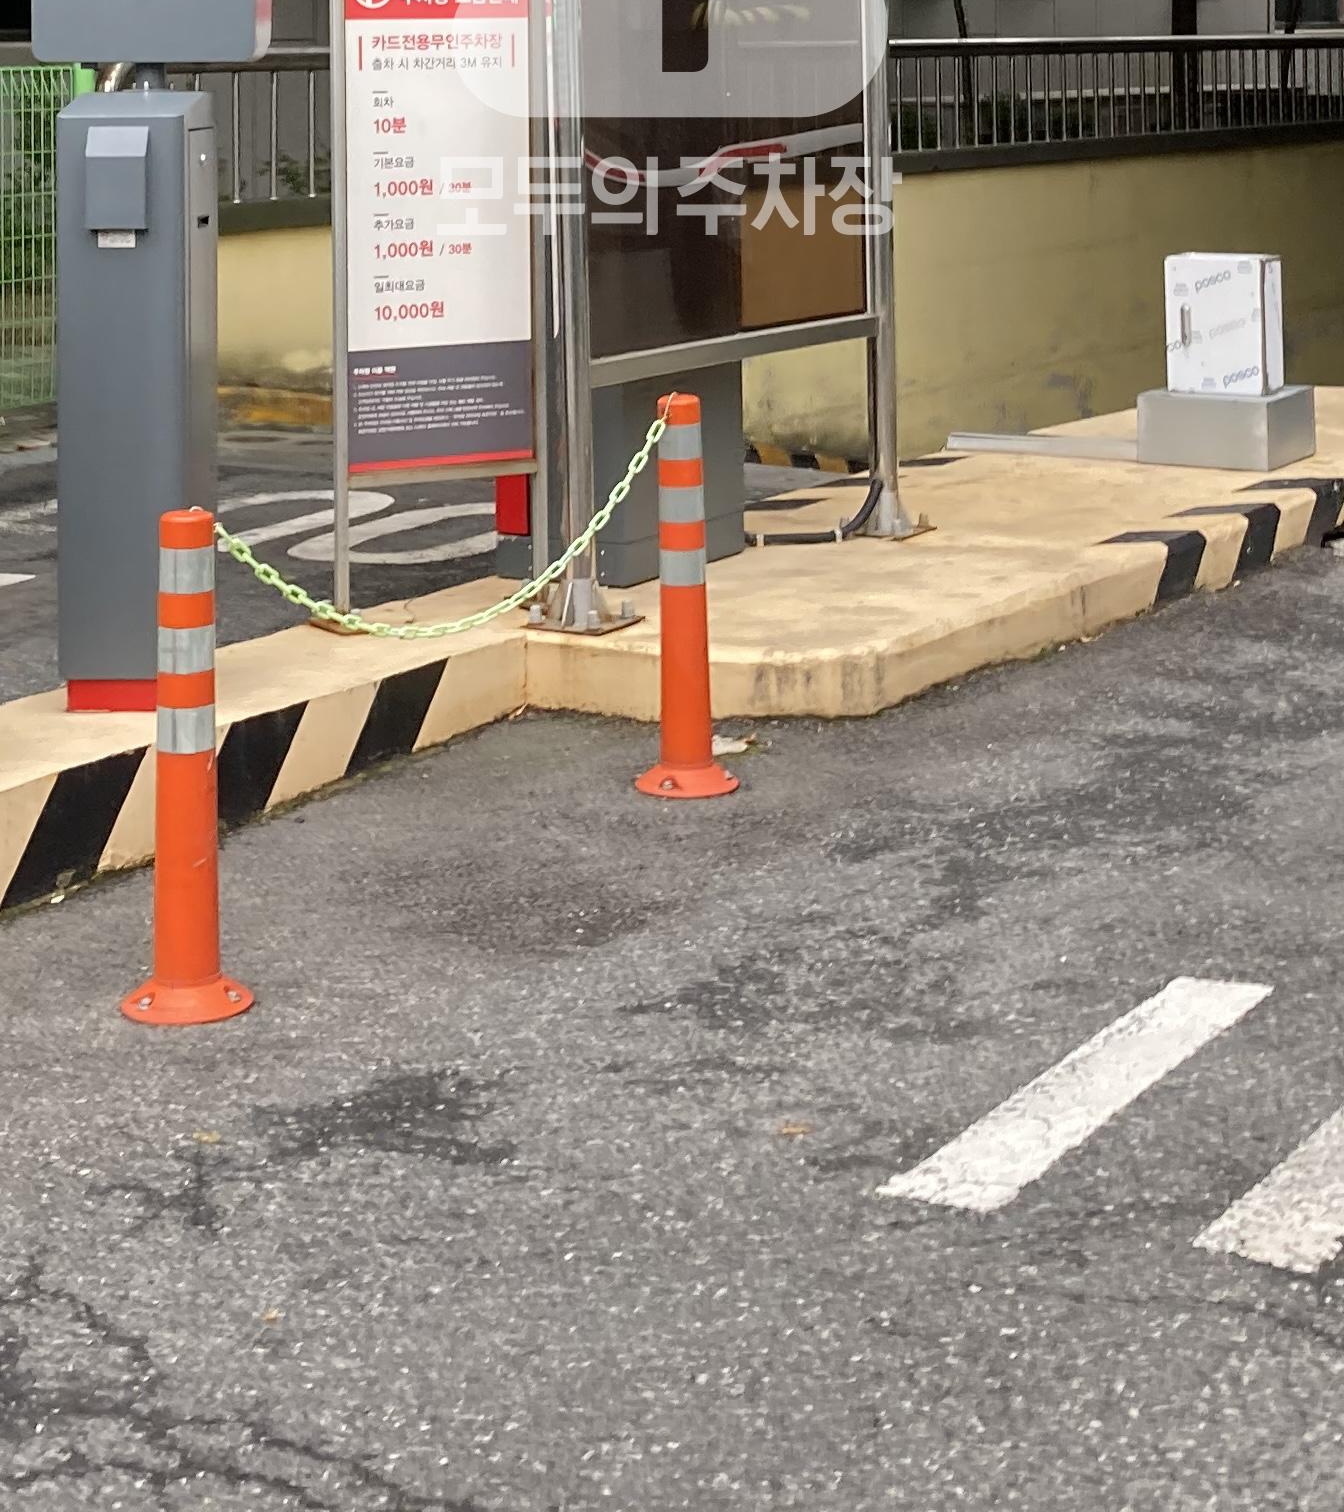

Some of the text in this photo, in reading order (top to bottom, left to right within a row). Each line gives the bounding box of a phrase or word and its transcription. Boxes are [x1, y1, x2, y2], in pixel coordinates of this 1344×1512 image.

[371, 33, 502, 51] 카드전용무인주차장
[398, 57, 409, 69] 시
[413, 57, 456, 70] 차간거리
[460, 56, 477, 68] 3M
[481, 56, 502, 68] 유지
[373, 116, 407, 135] 10분
[373, 156, 414, 169] 기본요금
[373, 178, 433, 198] 1,000원
[373, 218, 415, 231] 추가요금
[373, 239, 434, 260] 1,000원
[448, 242, 472, 256] 30분
[1194, 270, 1232, 294] posco
[373, 300, 445, 322] 10,000원
